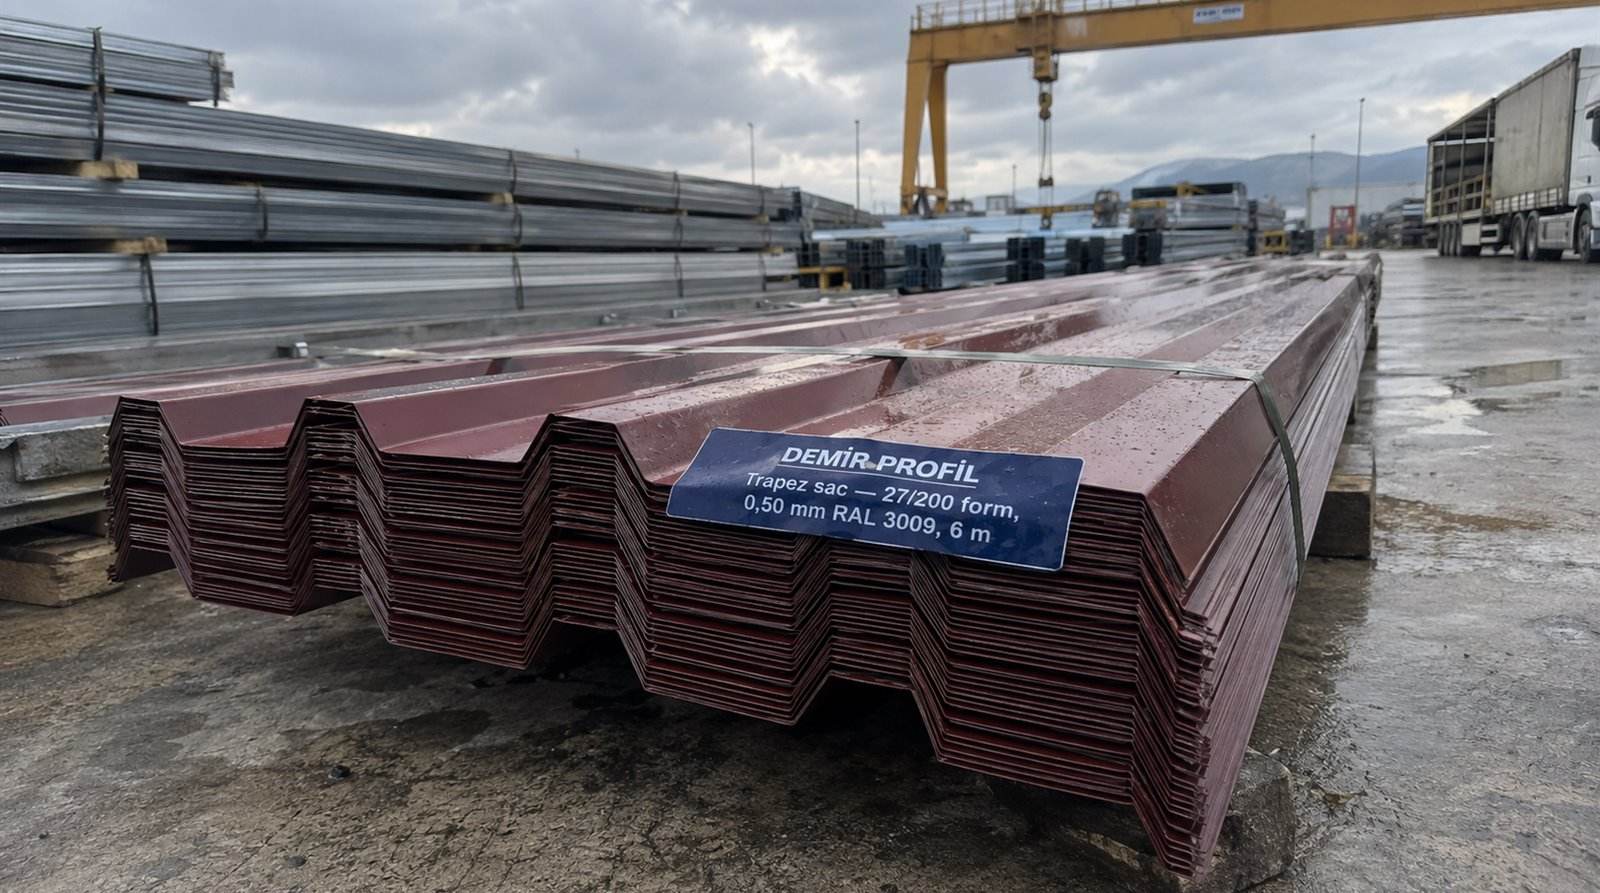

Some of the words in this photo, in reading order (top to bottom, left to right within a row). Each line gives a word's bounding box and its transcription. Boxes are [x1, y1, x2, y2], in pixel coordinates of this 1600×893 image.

[781, 446, 870, 469] DEMİR
[876, 455, 979, 483] PROFİL
[744, 494, 784, 514] 0,50
[790, 503, 826, 519] mm
[832, 505, 876, 526] RAL
[883, 511, 942, 538] 3009,
[950, 521, 963, 539] 6
[970, 526, 991, 542] m
[746, 472, 808, 493] Trapez
[814, 480, 848, 496] sac
[882, 486, 955, 511] 27/200
[961, 497, 1020, 523] form,
